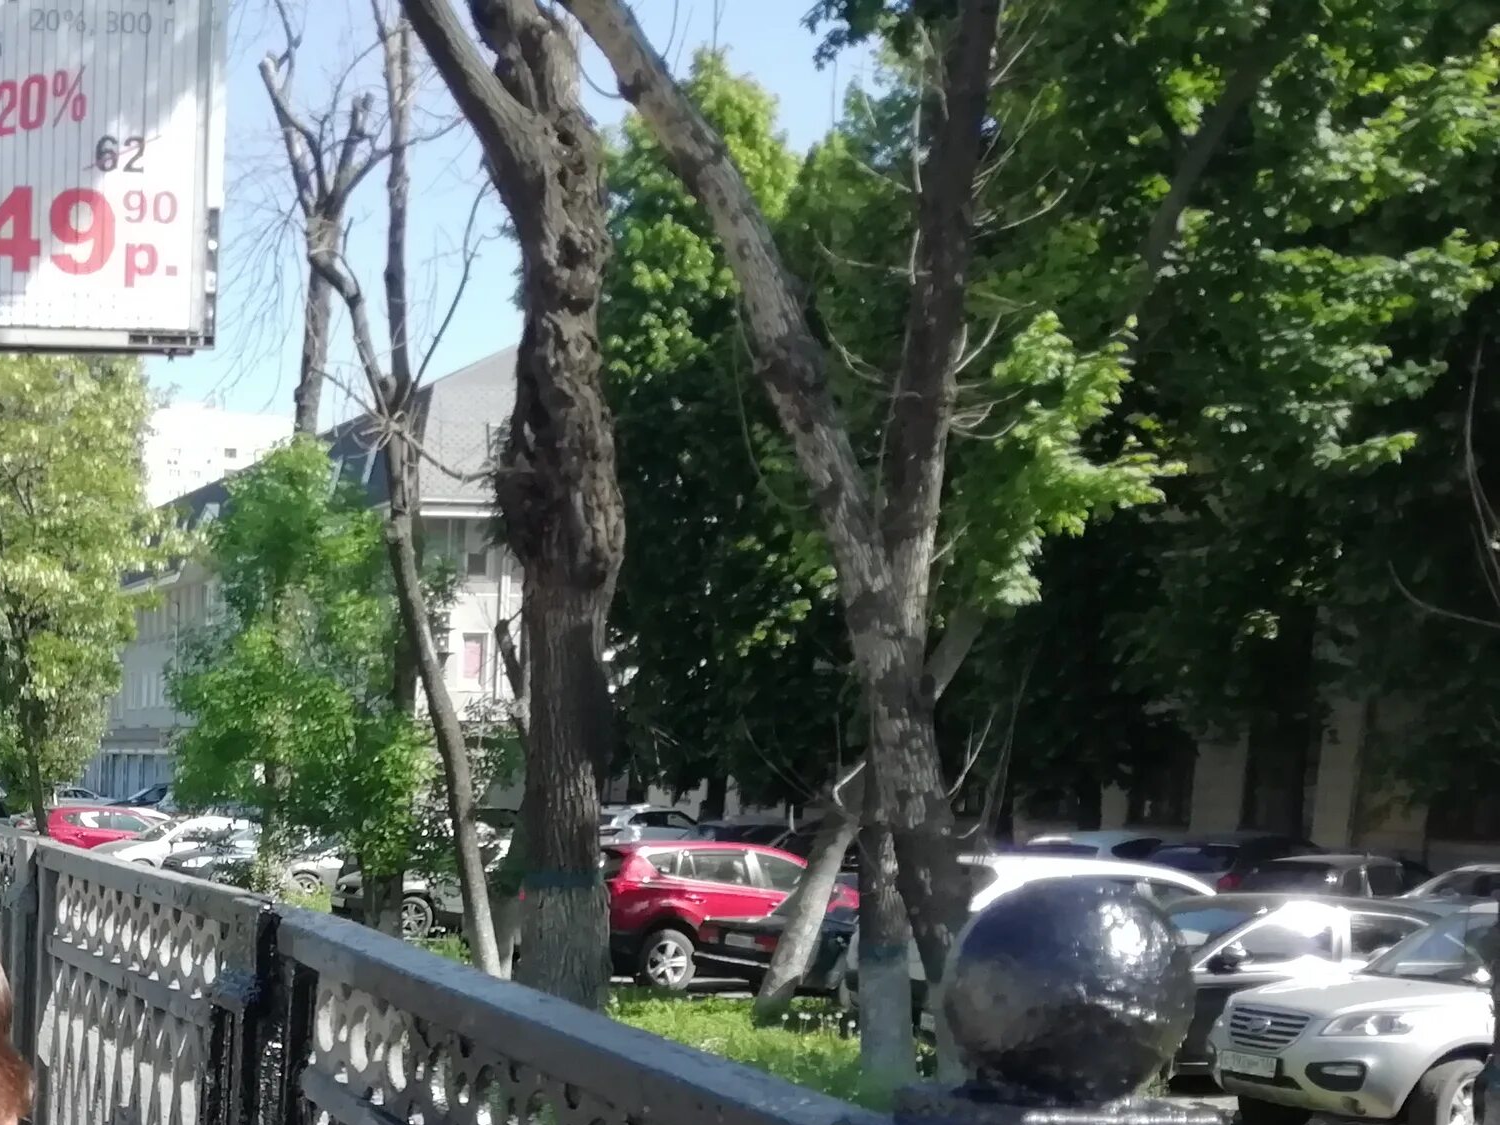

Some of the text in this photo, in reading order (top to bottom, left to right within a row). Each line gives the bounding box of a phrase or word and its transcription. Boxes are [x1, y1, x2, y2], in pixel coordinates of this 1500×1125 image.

[30, 9, 96, 36] 20%,
[106, 11, 152, 34] 300
[95, 135, 145, 173] 62
[122, 190, 178, 224] 90
